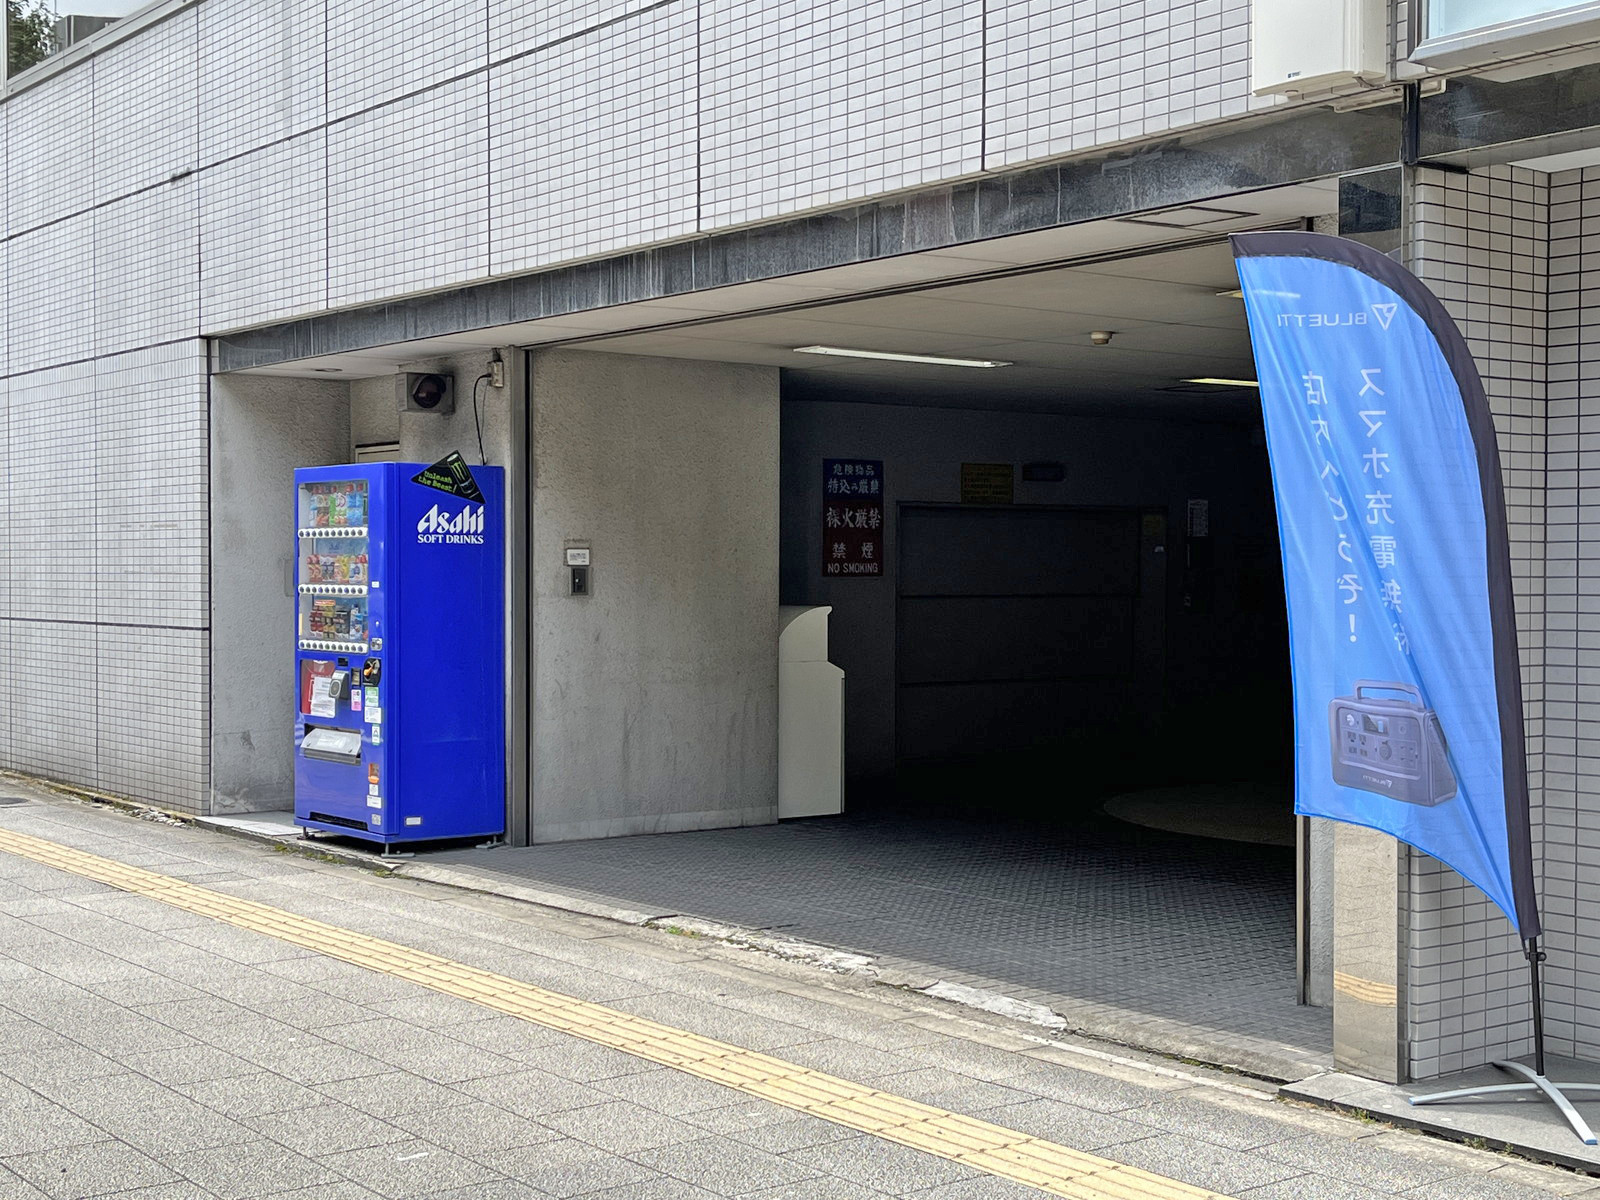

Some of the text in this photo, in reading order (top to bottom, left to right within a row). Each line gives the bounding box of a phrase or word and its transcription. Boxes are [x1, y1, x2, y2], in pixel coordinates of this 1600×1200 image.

[418, 475, 432, 486] the
[417, 504, 484, 533] Asahi
[417, 534, 484, 544] SOFT DRINKS
[827, 562, 879, 574] NO SMOKING
